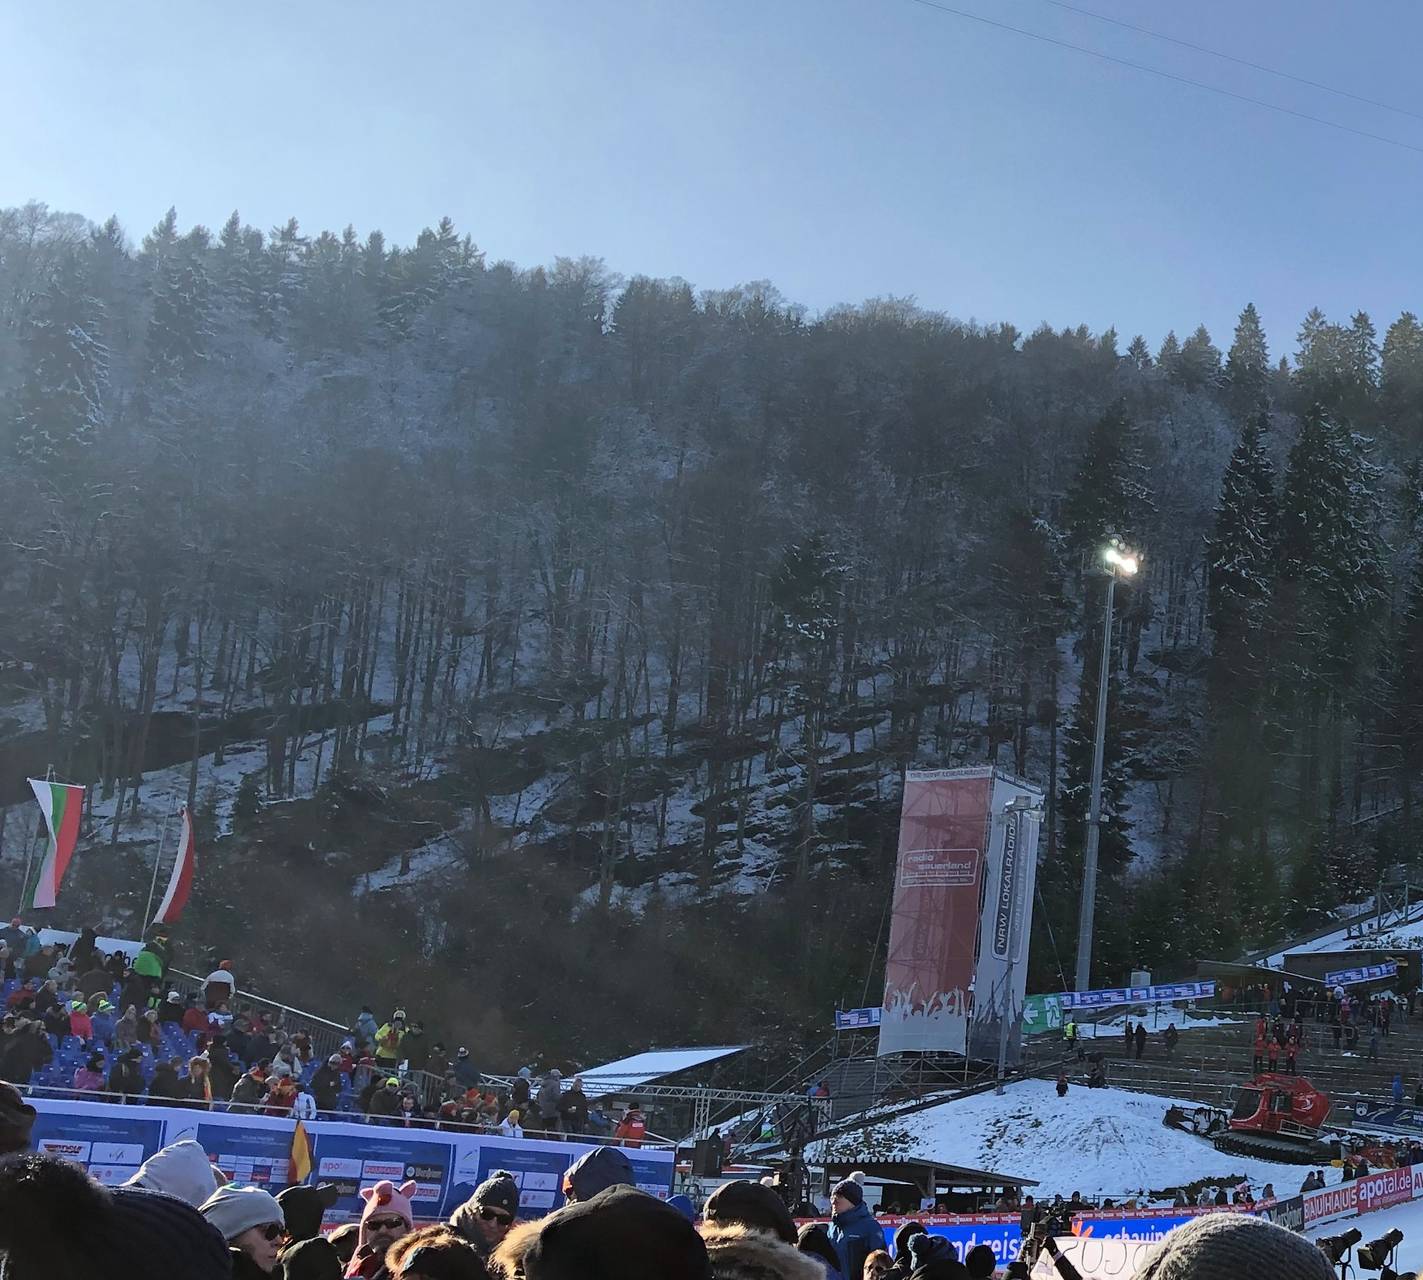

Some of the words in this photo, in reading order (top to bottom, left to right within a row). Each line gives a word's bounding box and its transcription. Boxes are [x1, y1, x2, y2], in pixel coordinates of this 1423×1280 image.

[997, 913, 1008, 948] NRW
[1303, 1188, 1358, 1220] BAUHAUS
[1360, 1170, 1412, 1207] apotal.de
